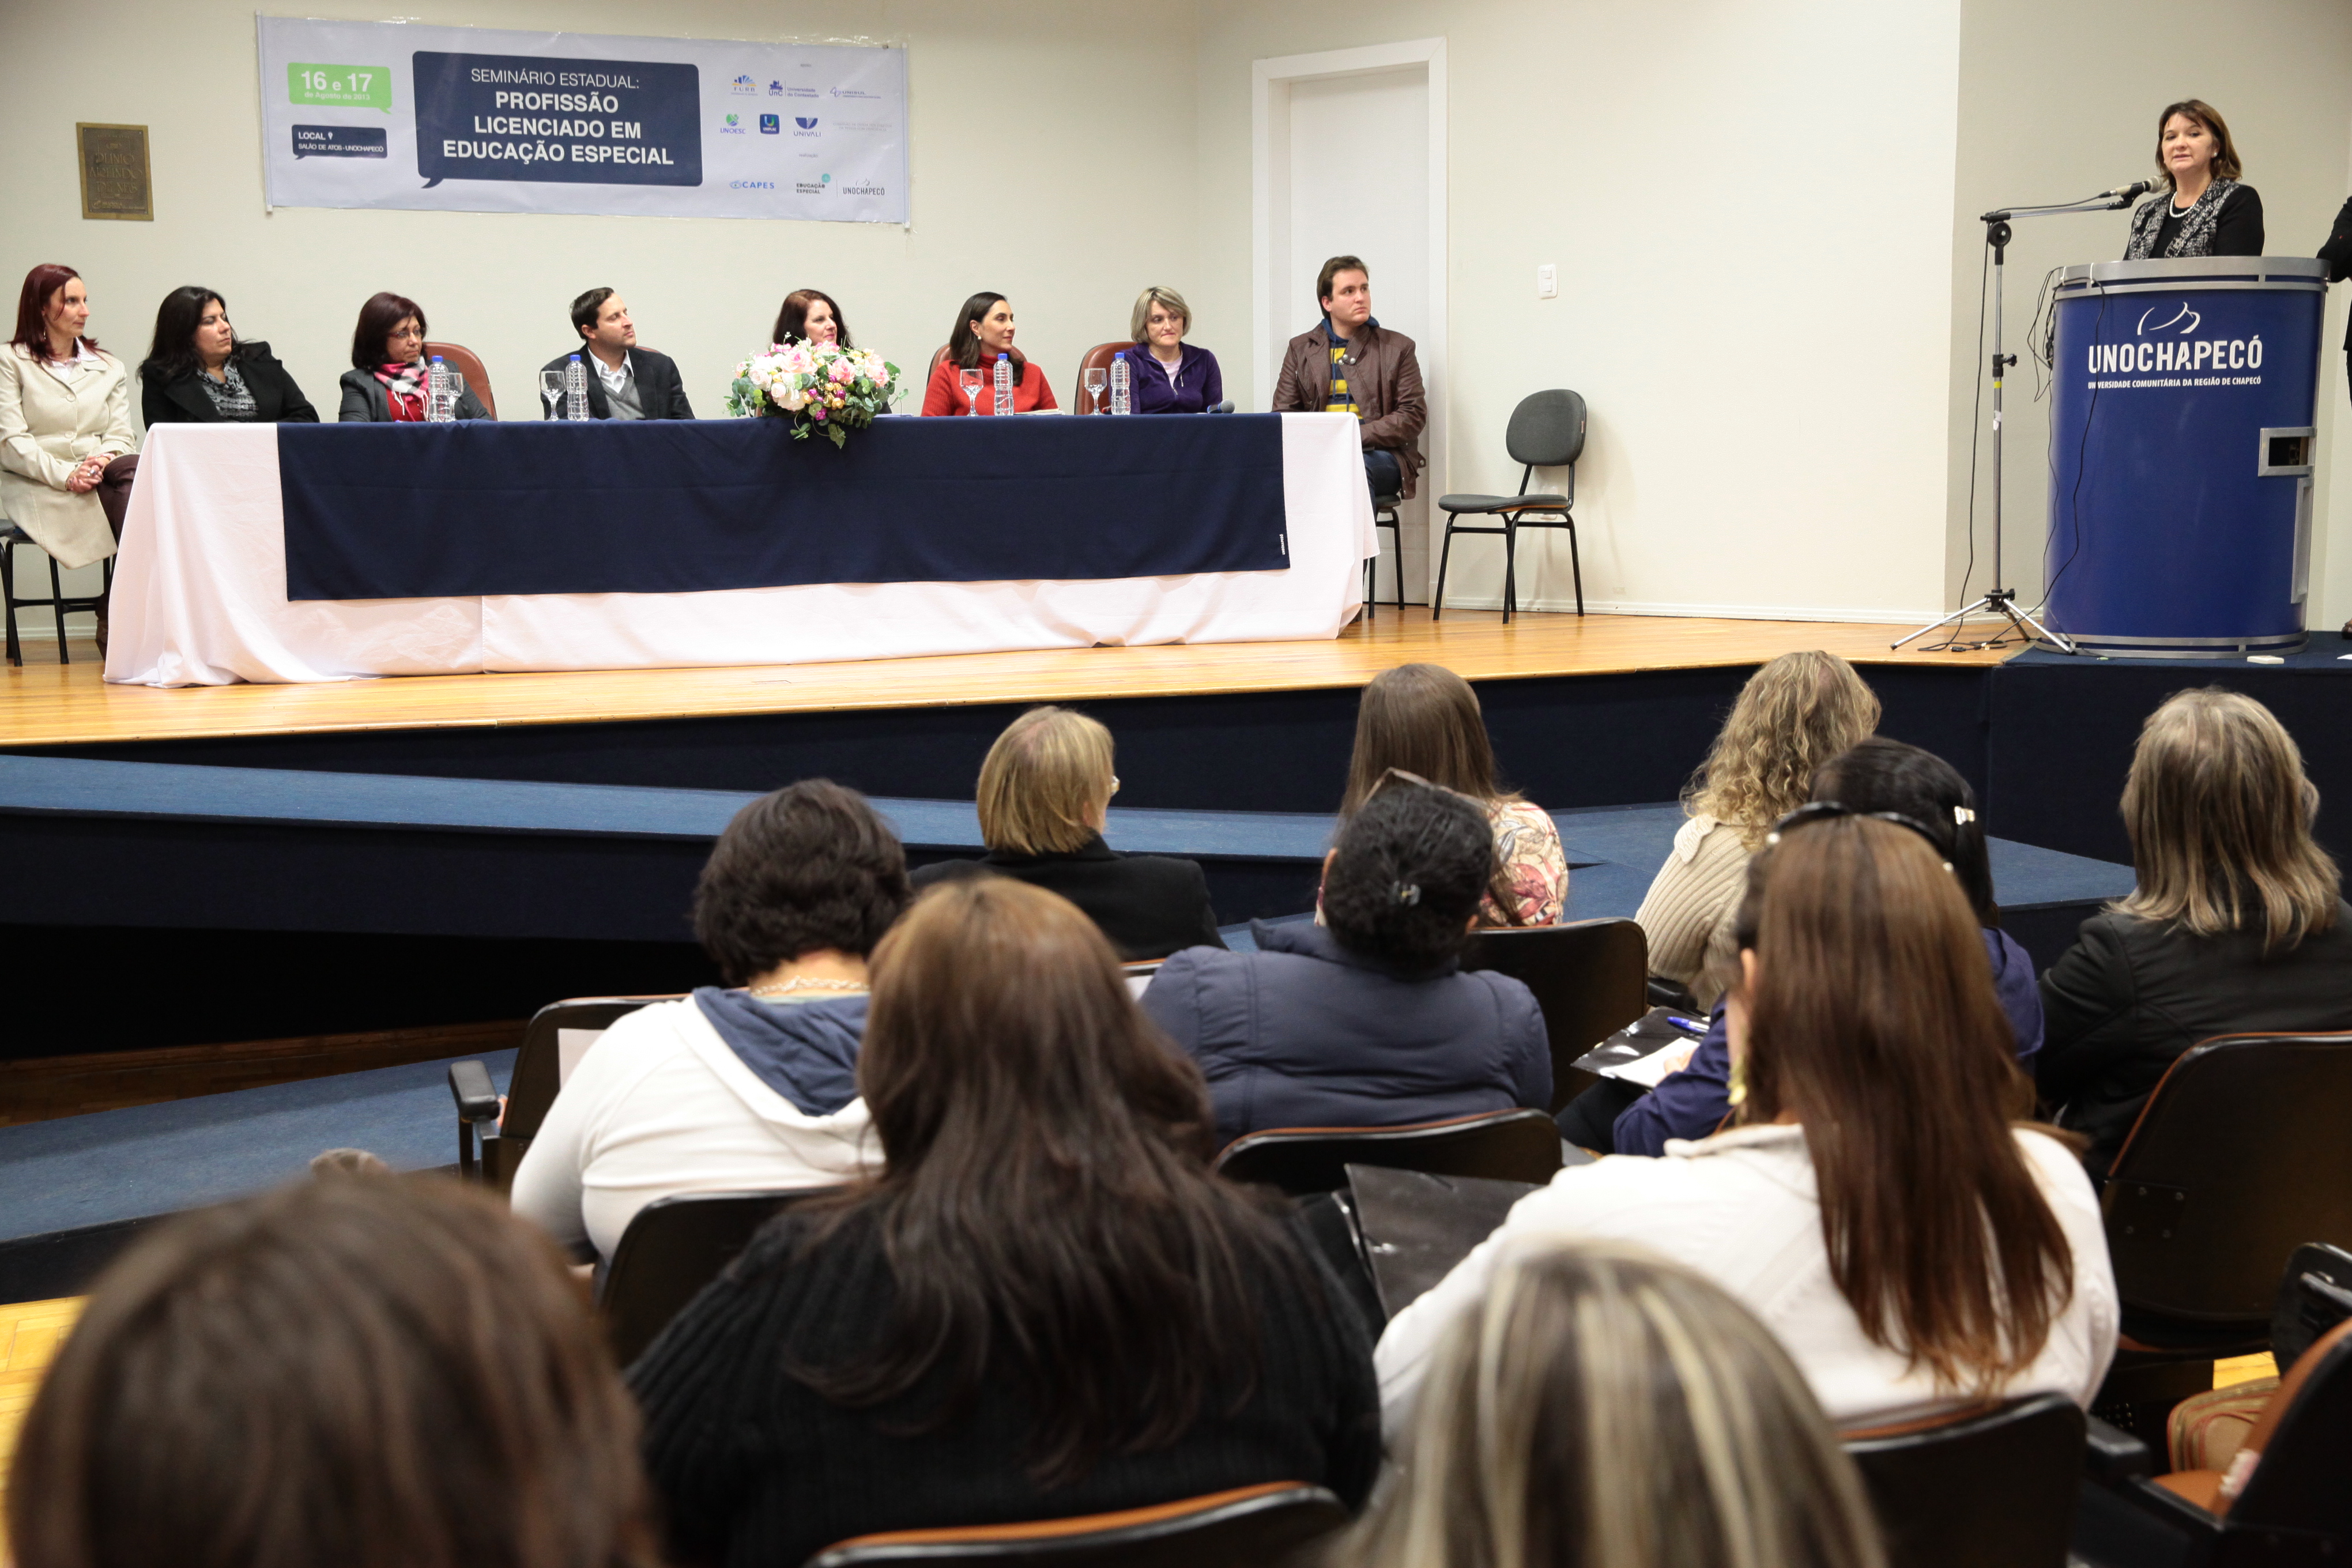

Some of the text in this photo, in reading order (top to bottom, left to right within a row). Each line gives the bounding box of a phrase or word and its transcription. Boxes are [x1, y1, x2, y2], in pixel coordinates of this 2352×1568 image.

[301, 71, 372, 92] 16 e 17
[472, 68, 639, 89] SEMINÁRIO ESTADUAL:
[315, 92, 341, 100] Agosto
[496, 91, 619, 114] PROFISSÃO
[298, 131, 326, 141] LOCAL
[474, 115, 642, 140] LICENCIADO EM
[443, 140, 674, 165] EDUCAÇÃO ESPECIAL
[742, 181, 775, 190] CAPES
[843, 186, 885, 196] UNOCHAPECÓ
[2088, 334, 2263, 374] UNOCHAPECÓ
[2088, 375, 2261, 390] UNVERSIDADE COMUNITÁRIA DA REGIÃO DE CHAPECÓ
